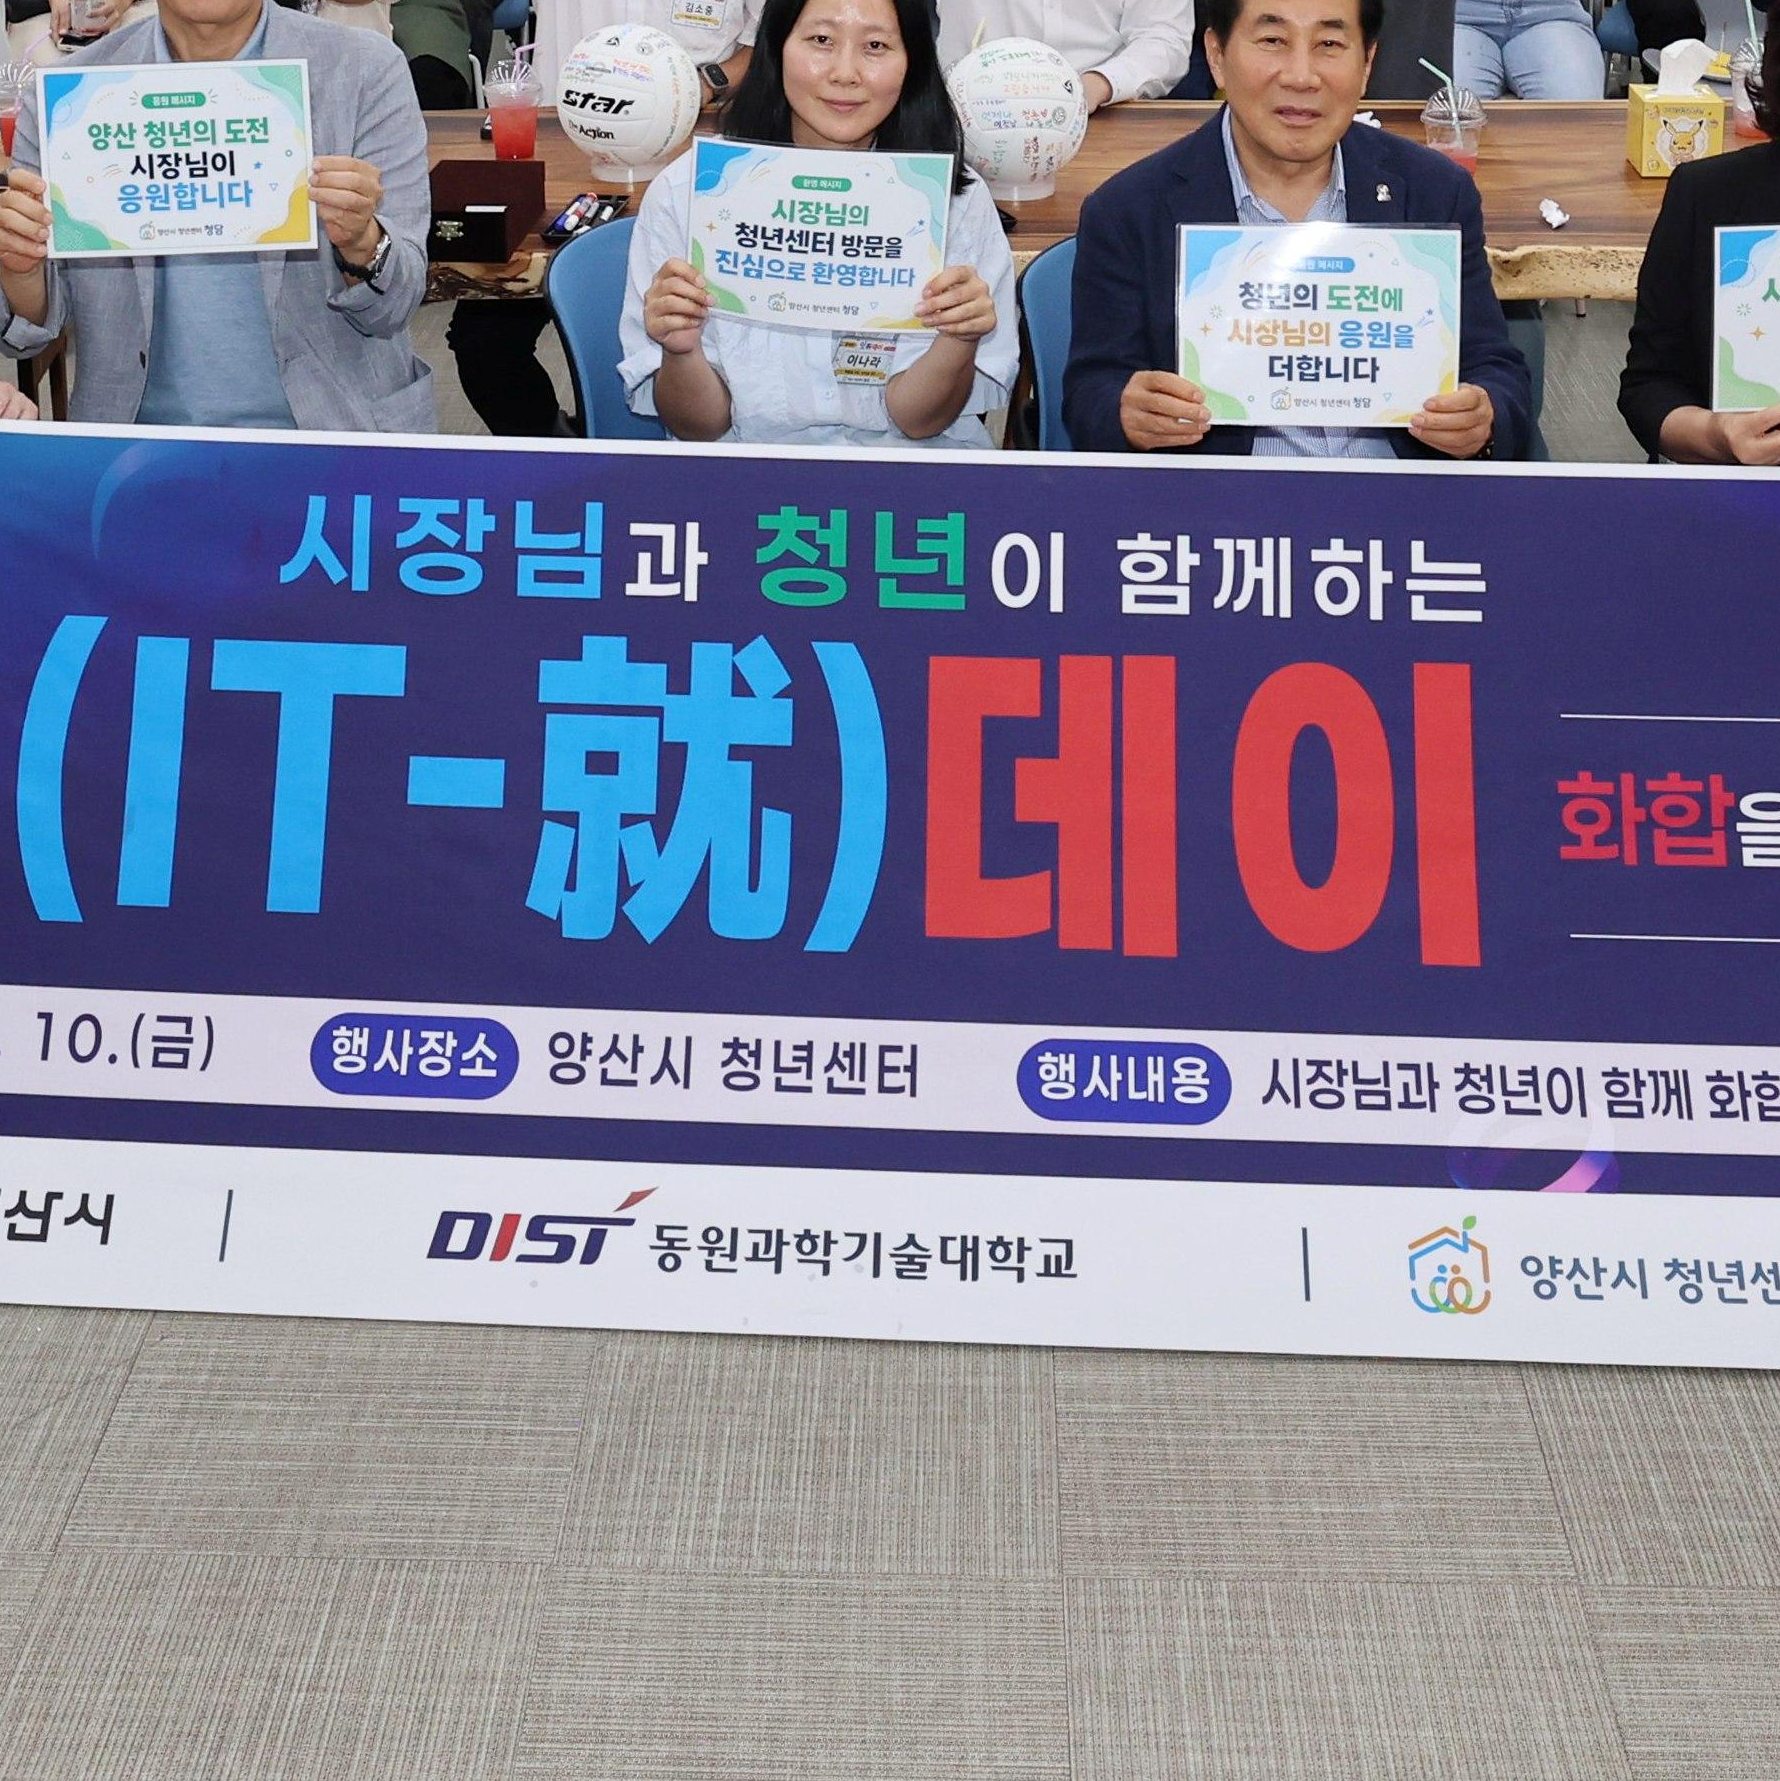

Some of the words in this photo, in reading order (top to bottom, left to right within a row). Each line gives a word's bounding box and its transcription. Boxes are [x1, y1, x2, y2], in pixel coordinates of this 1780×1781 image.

[170, 94, 196, 106] 메시지
[563, 89, 634, 115] star
[87, 121, 137, 151] 양산
[144, 119, 217, 149] 청년의
[225, 116, 269, 145] 도전
[130, 151, 236, 180] 시장님이
[118, 179, 253, 214] 응원합니다
[820, 179, 842, 190] 메시지
[771, 198, 870, 227] 시장님의
[204, 224, 224, 236] 청담
[734, 222, 835, 256] 청년센터
[841, 234, 903, 259] 방문을
[715, 248, 807, 283] 진심으로
[813, 262, 916, 288] 환영합니다
[842, 304, 860, 316] 청담
[1238, 282, 1318, 311] 청년의
[1326, 284, 1403, 312] 도전에
[1338, 320, 1415, 350] 응원을
[847, 354, 881, 368] 이나라
[1268, 355, 1381, 383] 더합니다
[1352, 395, 1371, 409] 청담
[279, 493, 710, 606] 시장님과
[753, 505, 1066, 616] 청년이
[1116, 530, 1488, 624] 함께하는
[330, 1025, 499, 1079] 행사장소
[546, 1031, 694, 1091] 양산시
[721, 1036, 921, 1101] 청년센터
[1035, 1049, 1212, 1107] 행사내용
[1261, 1056, 1440, 1116] 시장님과
[1452, 1062, 1588, 1121] 청년이
[1600, 1066, 1695, 1125] 함께
[426, 1205, 637, 1266] DIST
[647, 1221, 1080, 1285] 동원과학기술대학교
[1519, 1250, 1649, 1304] 양산시
